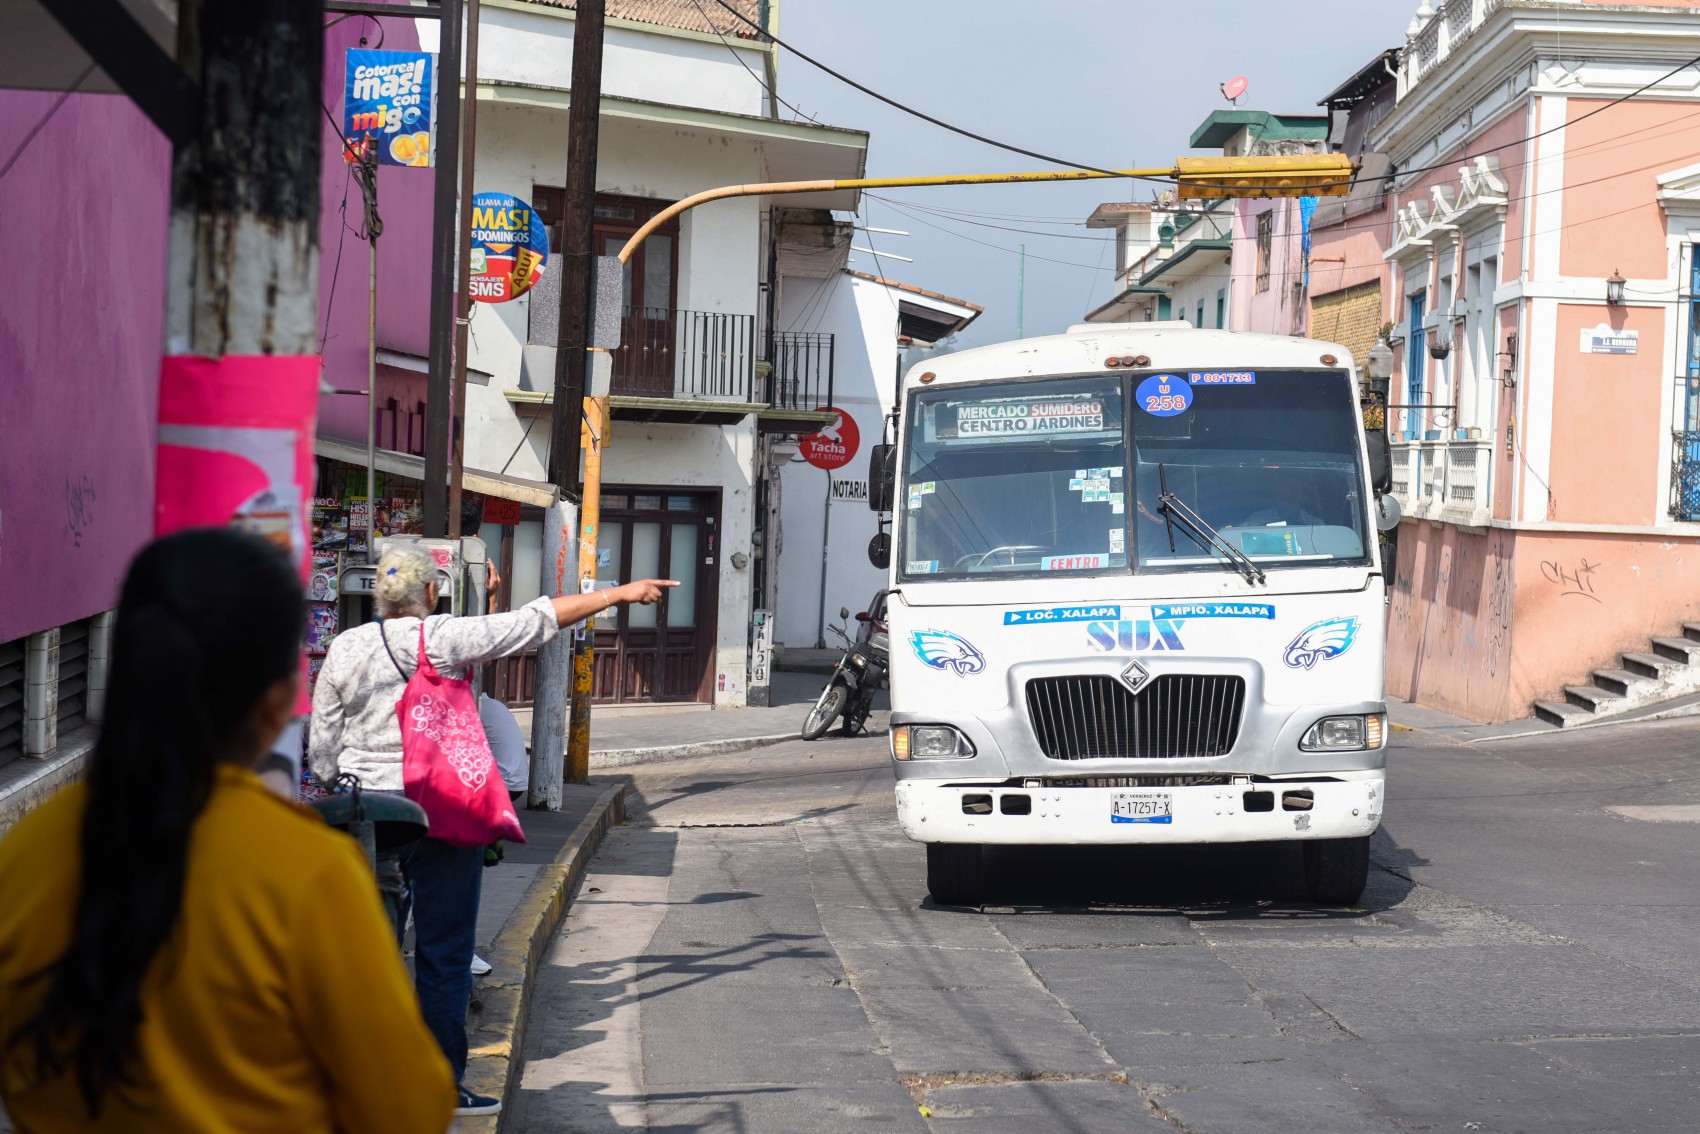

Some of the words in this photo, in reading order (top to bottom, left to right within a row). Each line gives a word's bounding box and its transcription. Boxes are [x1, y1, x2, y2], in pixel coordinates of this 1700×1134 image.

[355, 62, 414, 80] Cotorrea
[392, 94, 420, 106] con
[352, 104, 422, 134] migo
[478, 198, 501, 206] LLAMA
[503, 198, 518, 207] AÚN
[472, 208, 529, 231] MÁS!
[478, 231, 530, 242] DOMINGOS
[514, 251, 534, 288] AQUÍ
[469, 282, 504, 296] SMS
[1192, 374, 1201, 382] P
[1204, 373, 1252, 382] 001733
[1158, 385, 1170, 394] U
[958, 404, 1028, 419] MERCADO
[1031, 402, 1101, 416] SUMIDERO
[1146, 395, 1186, 412] 258
[960, 418, 1028, 432] CENTRO
[1032, 416, 1102, 430] JARDINES
[810, 441, 846, 454] Tacha
[824, 453, 845, 461] store
[833, 480, 867, 499] NOTARIA
[1050, 557, 1100, 570] CENTRO
[1026, 610, 1057, 621] LOC.
[1061, 608, 1116, 618] XALAPA
[1170, 606, 1210, 616] MPIO.
[1214, 605, 1270, 616] XALAPA
[1086, 620, 1186, 651] SUX
[1114, 801, 1170, 815] A-17257-X
